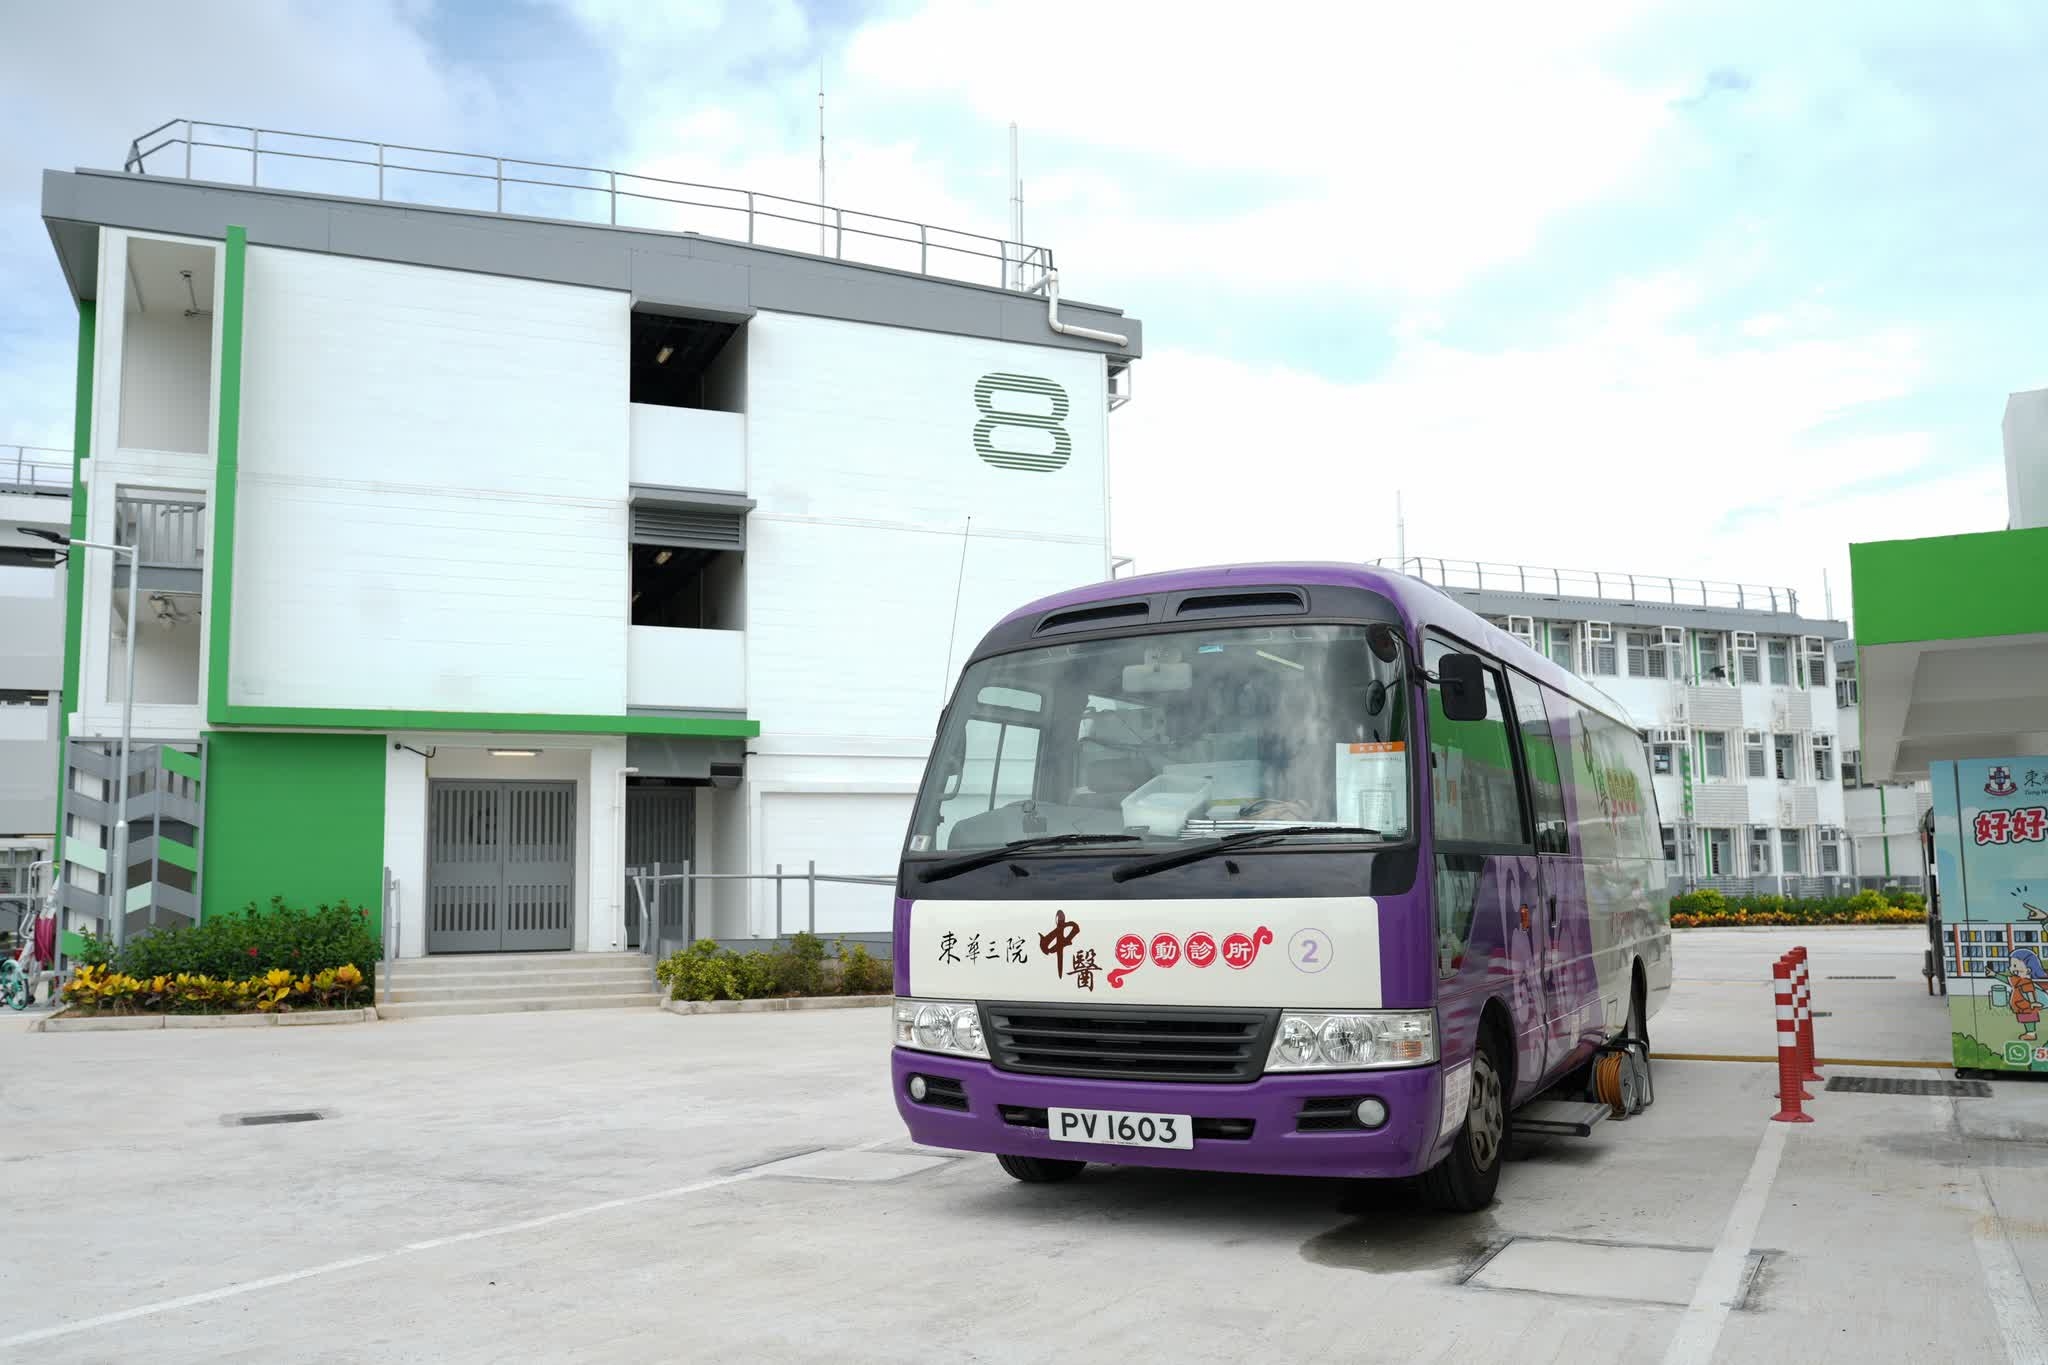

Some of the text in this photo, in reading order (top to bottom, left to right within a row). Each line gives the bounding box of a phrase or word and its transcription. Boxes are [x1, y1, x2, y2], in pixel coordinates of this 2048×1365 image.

[973, 373, 1072, 472] 8
[939, 909, 1318, 992] 東華三院 中醫 流動診所 2
[1061, 1112, 1177, 1143] PV 1603
